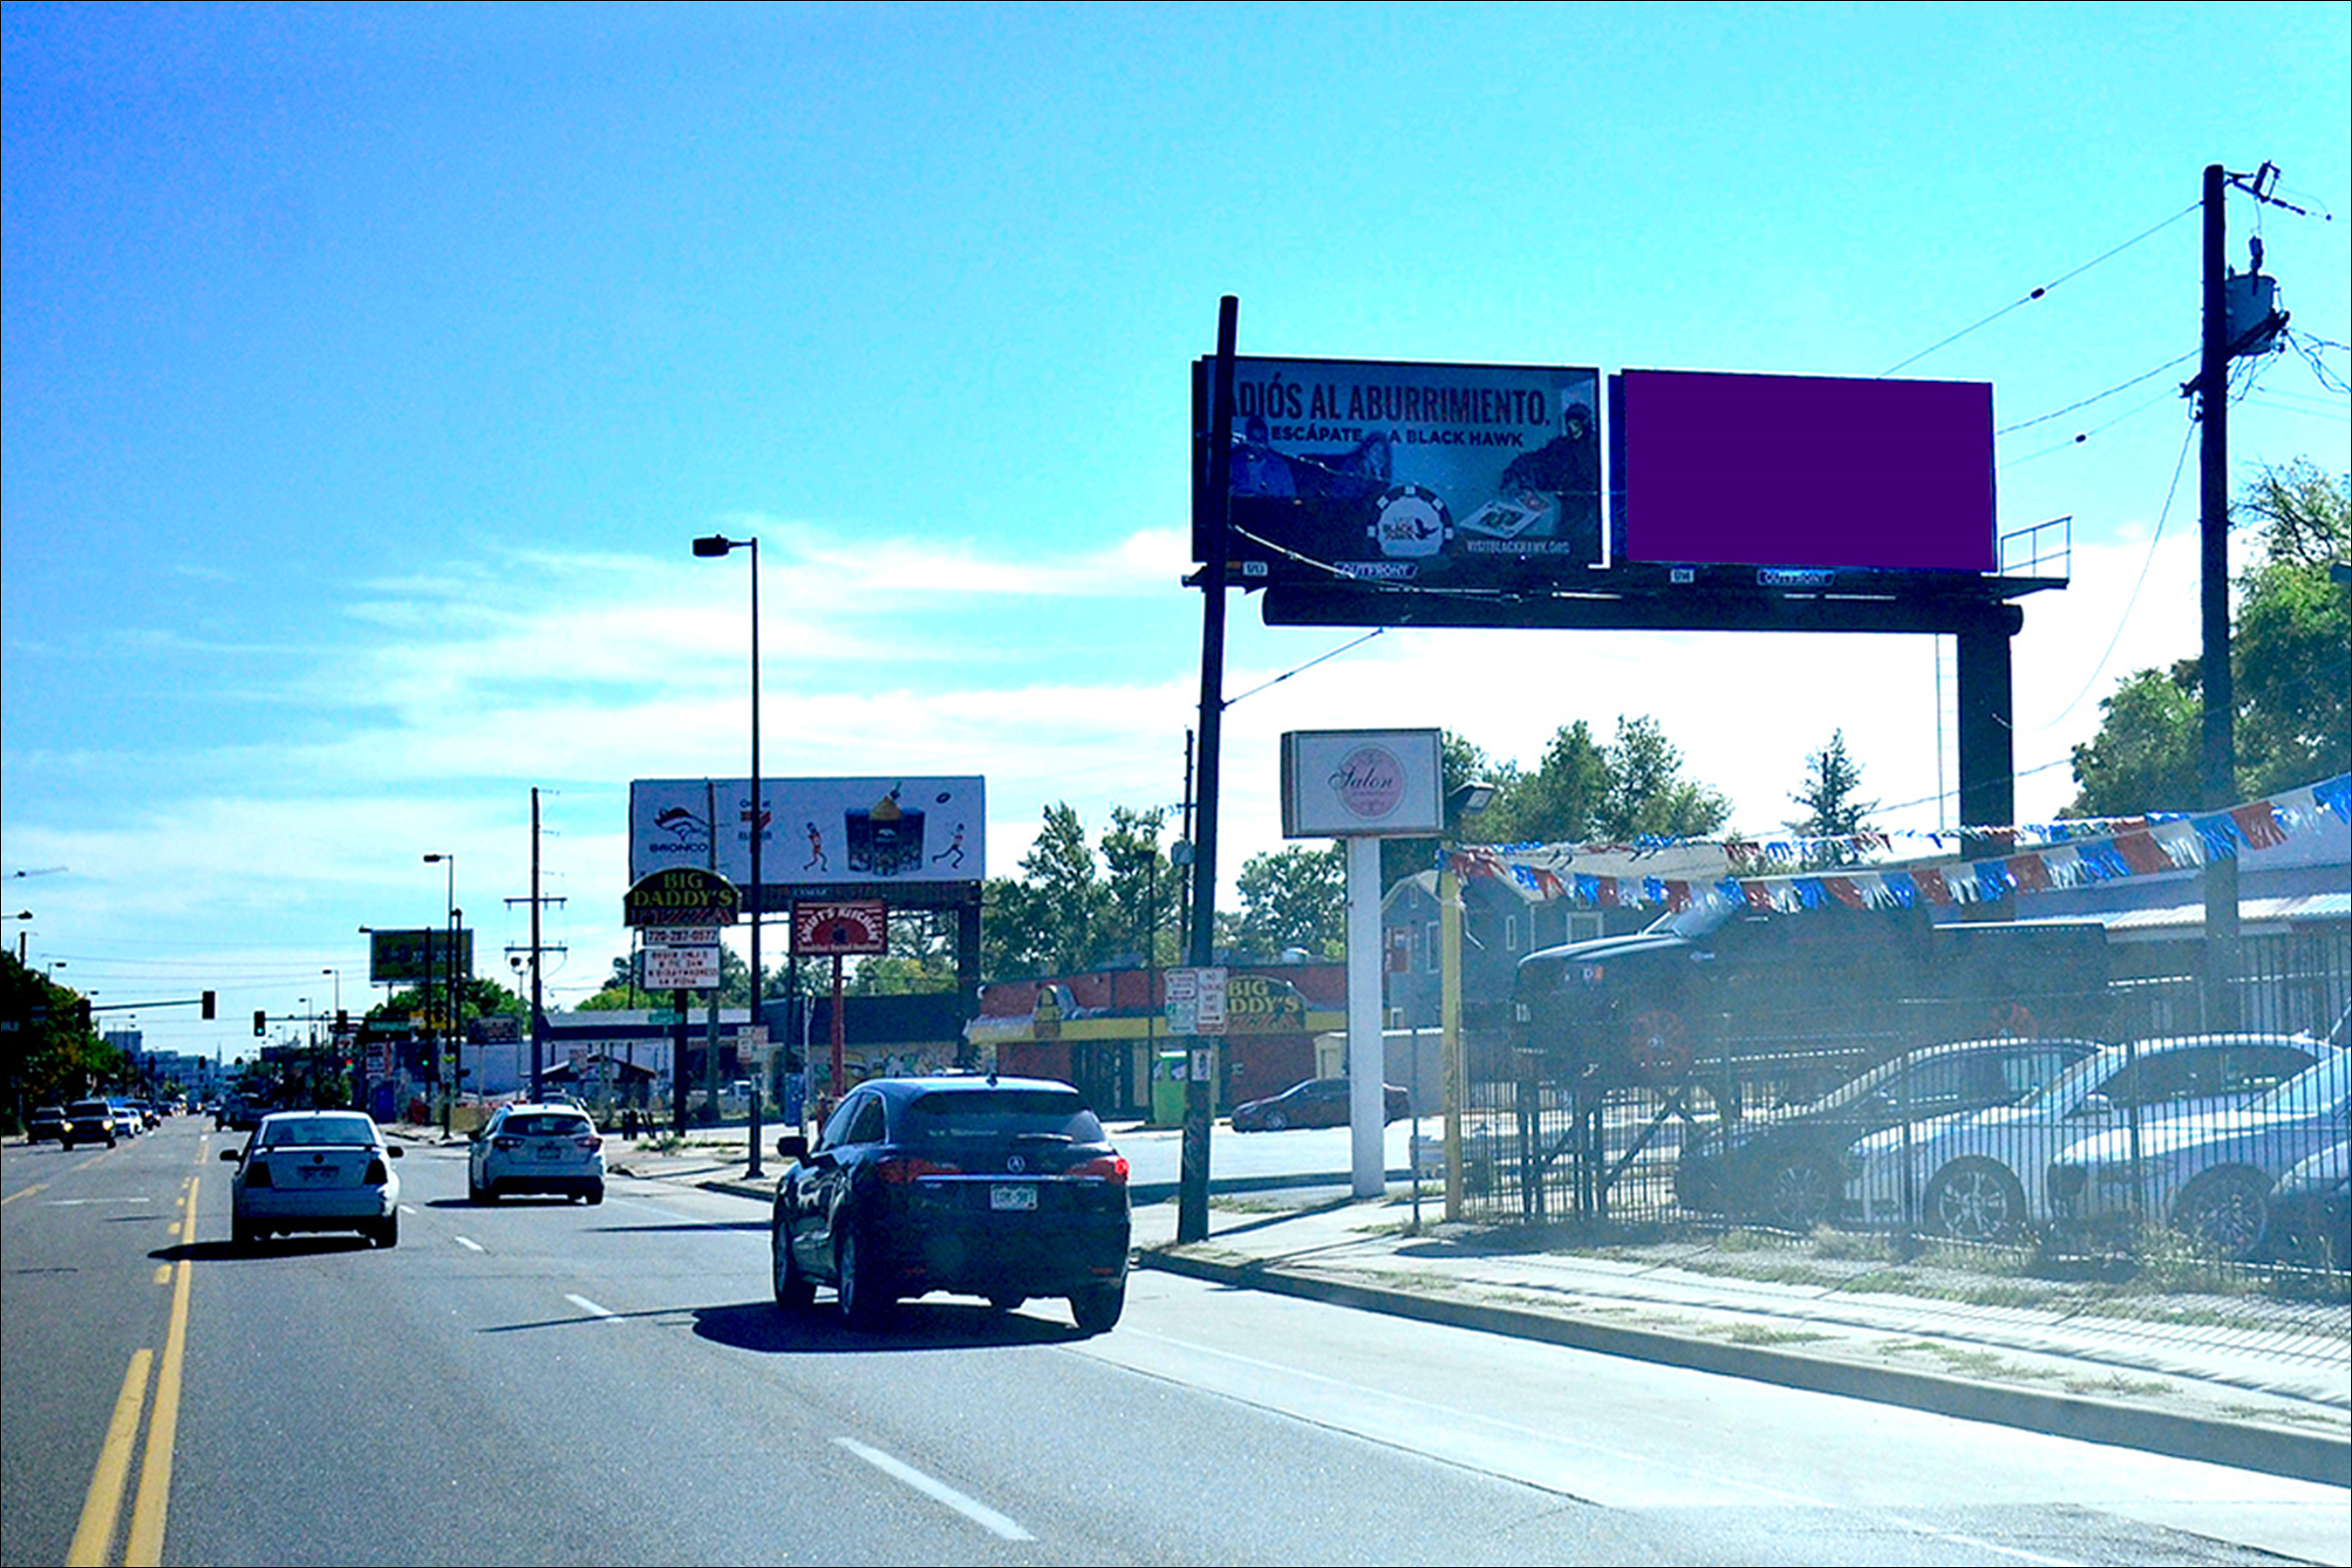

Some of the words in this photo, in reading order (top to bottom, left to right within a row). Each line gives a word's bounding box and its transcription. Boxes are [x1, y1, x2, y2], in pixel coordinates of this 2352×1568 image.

[1310, 383, 1342, 419] AL
[1348, 385, 1550, 426] ABURRIMIENTO.
[1271, 423, 1362, 442] ESCÁPATE
[1390, 429, 1401, 441] A
[1406, 429, 1465, 445] BLACK
[1470, 431, 1523, 447] HAWK
[650, 844, 708, 853] BRONCO
[663, 872, 704, 889] BIG
[634, 890, 733, 906] DADDY'S
[1228, 981, 1269, 997] BIG
[1226, 998, 1300, 1013] DDY'S
